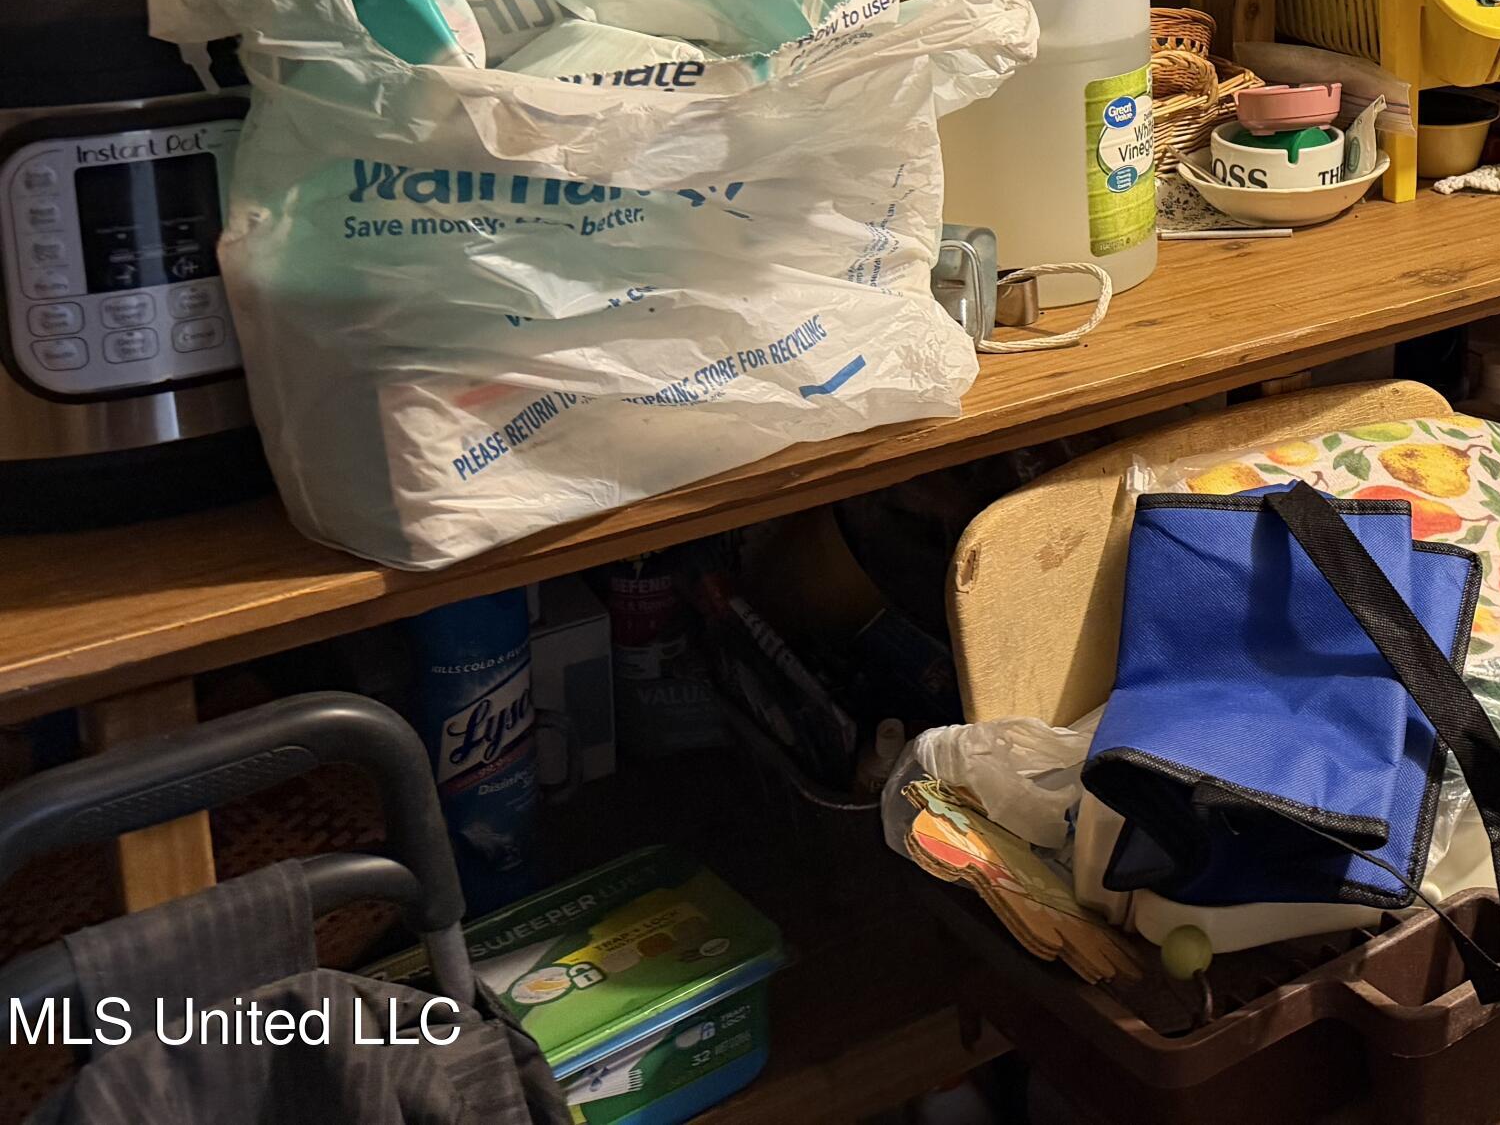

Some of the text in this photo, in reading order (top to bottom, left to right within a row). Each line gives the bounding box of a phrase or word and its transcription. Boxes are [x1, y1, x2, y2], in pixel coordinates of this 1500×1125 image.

[842, 9, 859, 28] to
[1108, 102, 1132, 118] Great
[1114, 112, 1133, 123] Value
[77, 131, 203, 164] Instant Pot
[349, 158, 650, 206] Walma
[344, 206, 645, 238] Save money. better.
[453, 432, 509, 481] PLEASE
[503, 394, 559, 448] RETURN
[693, 355, 739, 394] STORE
[737, 348, 769, 373] FOR
[769, 314, 829, 365] RECYCLING
[432, 665, 461, 674] KILLS
[463, 659, 495, 673] COLD
[468, 893, 598, 958] SWEEPER
